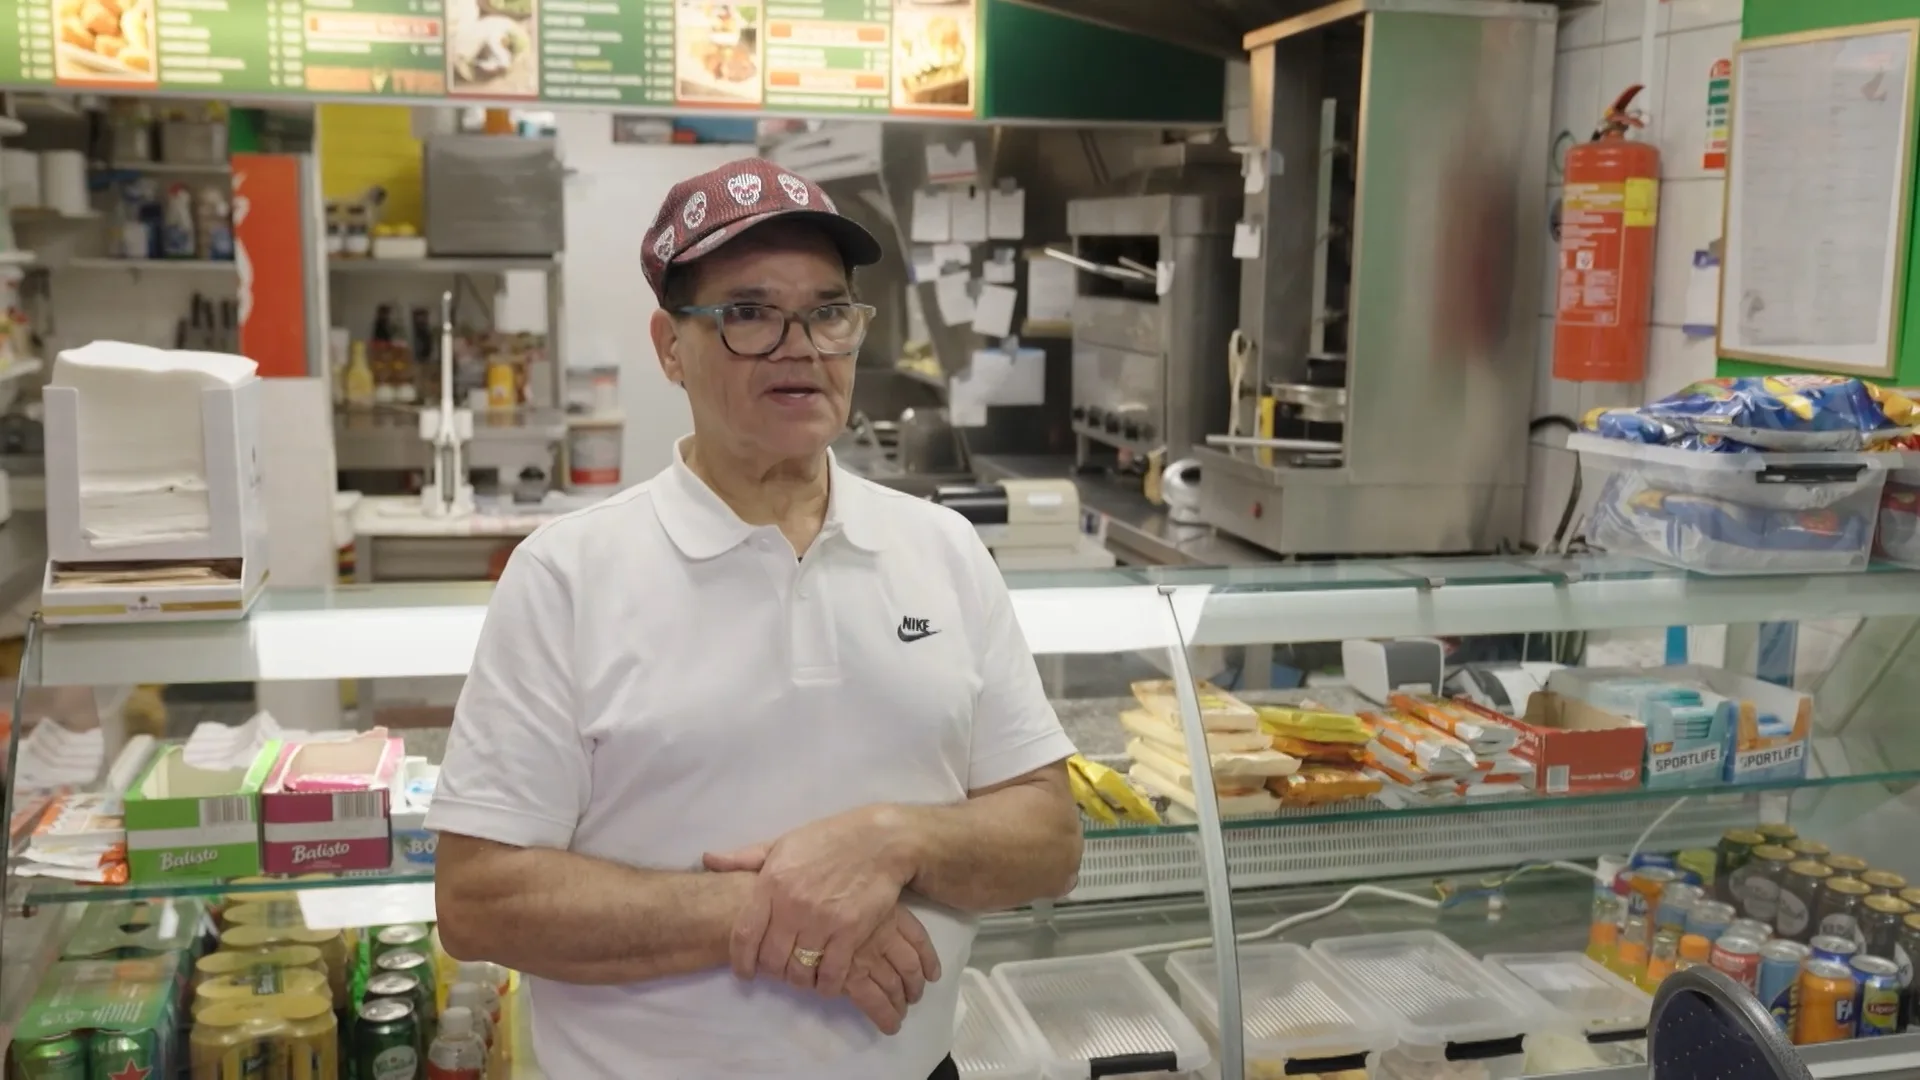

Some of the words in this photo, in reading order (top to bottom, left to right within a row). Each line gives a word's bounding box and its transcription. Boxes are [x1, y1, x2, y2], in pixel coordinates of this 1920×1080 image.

[902, 615, 930, 633] NIKE
[1655, 748, 1716, 772] SPORTLIFE
[159, 848, 218, 871] Balisto
[292, 840, 351, 864] Balisto
